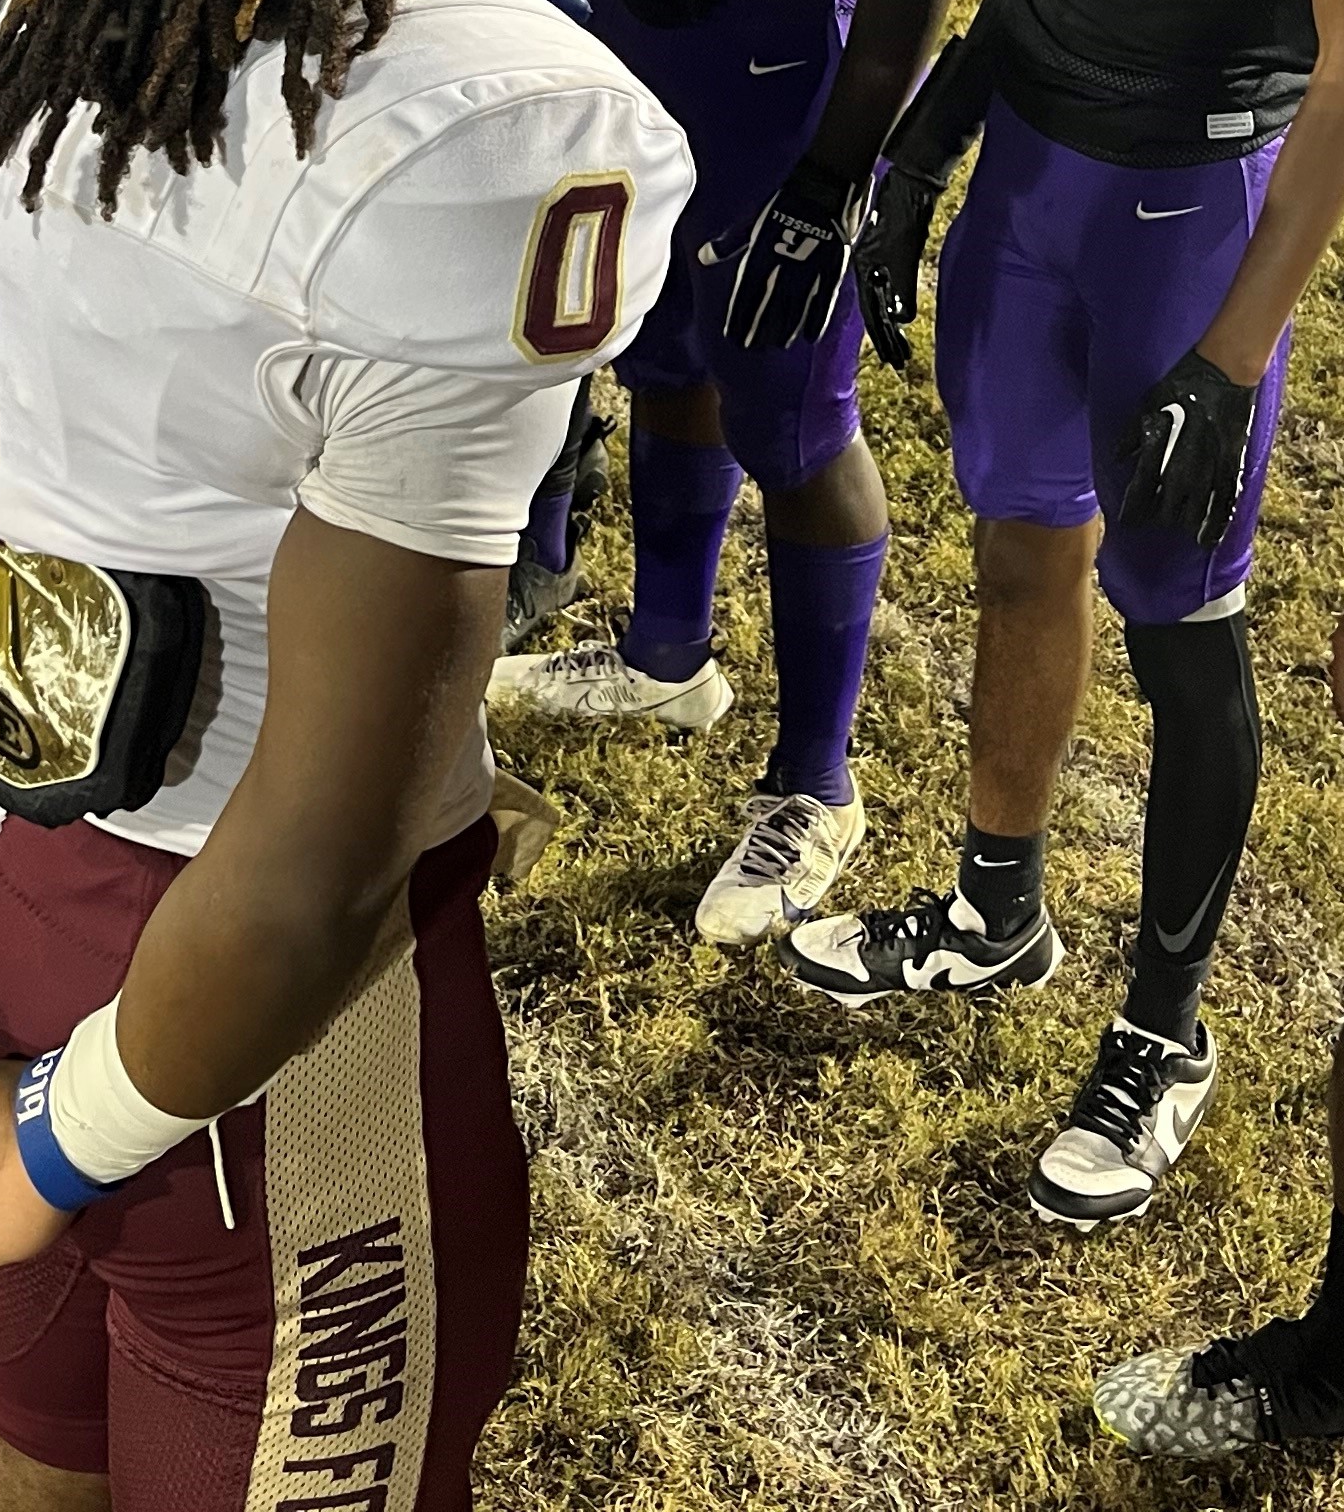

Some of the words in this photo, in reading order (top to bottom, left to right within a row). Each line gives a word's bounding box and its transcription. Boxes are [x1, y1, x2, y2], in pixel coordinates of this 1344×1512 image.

[510, 169, 637, 365] 0
[772, 209, 834, 241] RUSSELL
[291, 1216, 409, 1439] KINGS
